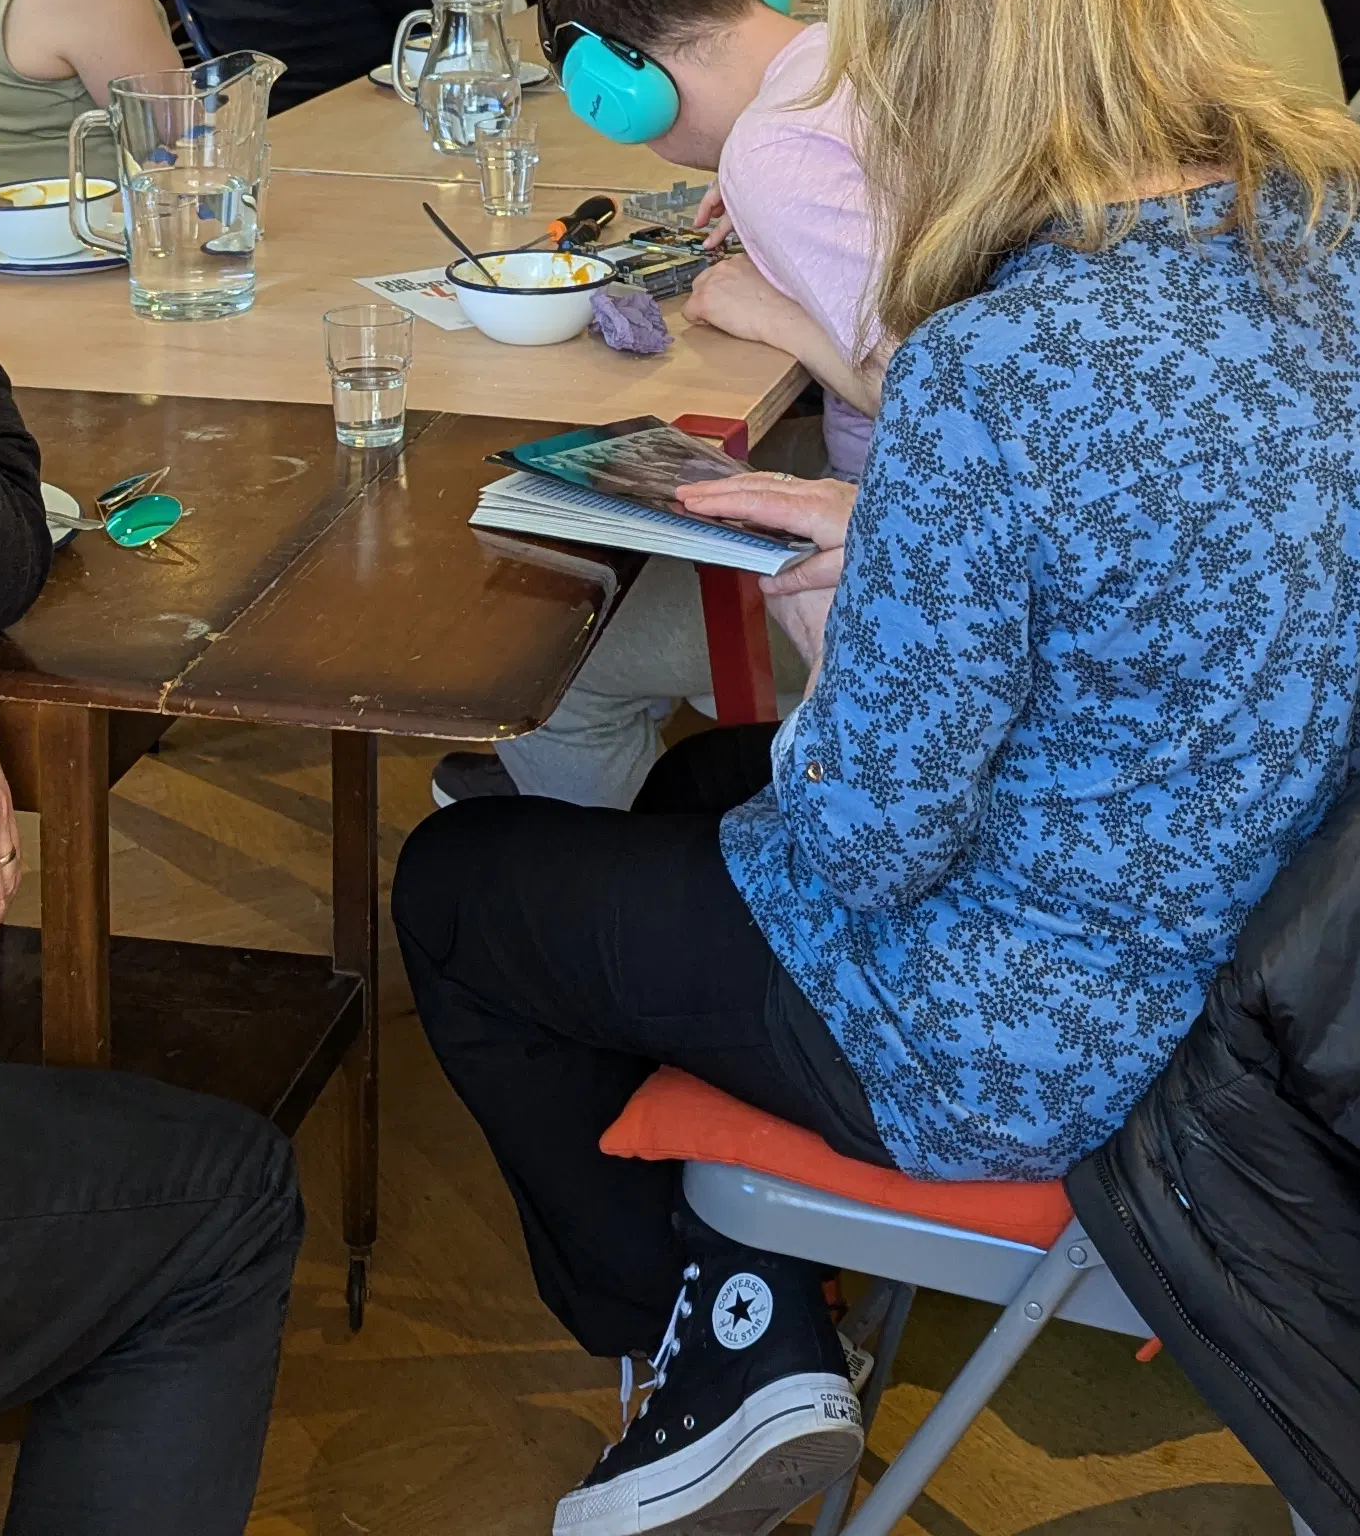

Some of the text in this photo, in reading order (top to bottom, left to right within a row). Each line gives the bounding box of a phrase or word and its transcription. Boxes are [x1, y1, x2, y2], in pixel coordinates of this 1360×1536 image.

[374, 277, 415, 288] OUR
[718, 1278, 764, 1311] CONVERSE
[722, 1317, 763, 1343] ALL STAR
[822, 1401, 839, 1420] ALL
